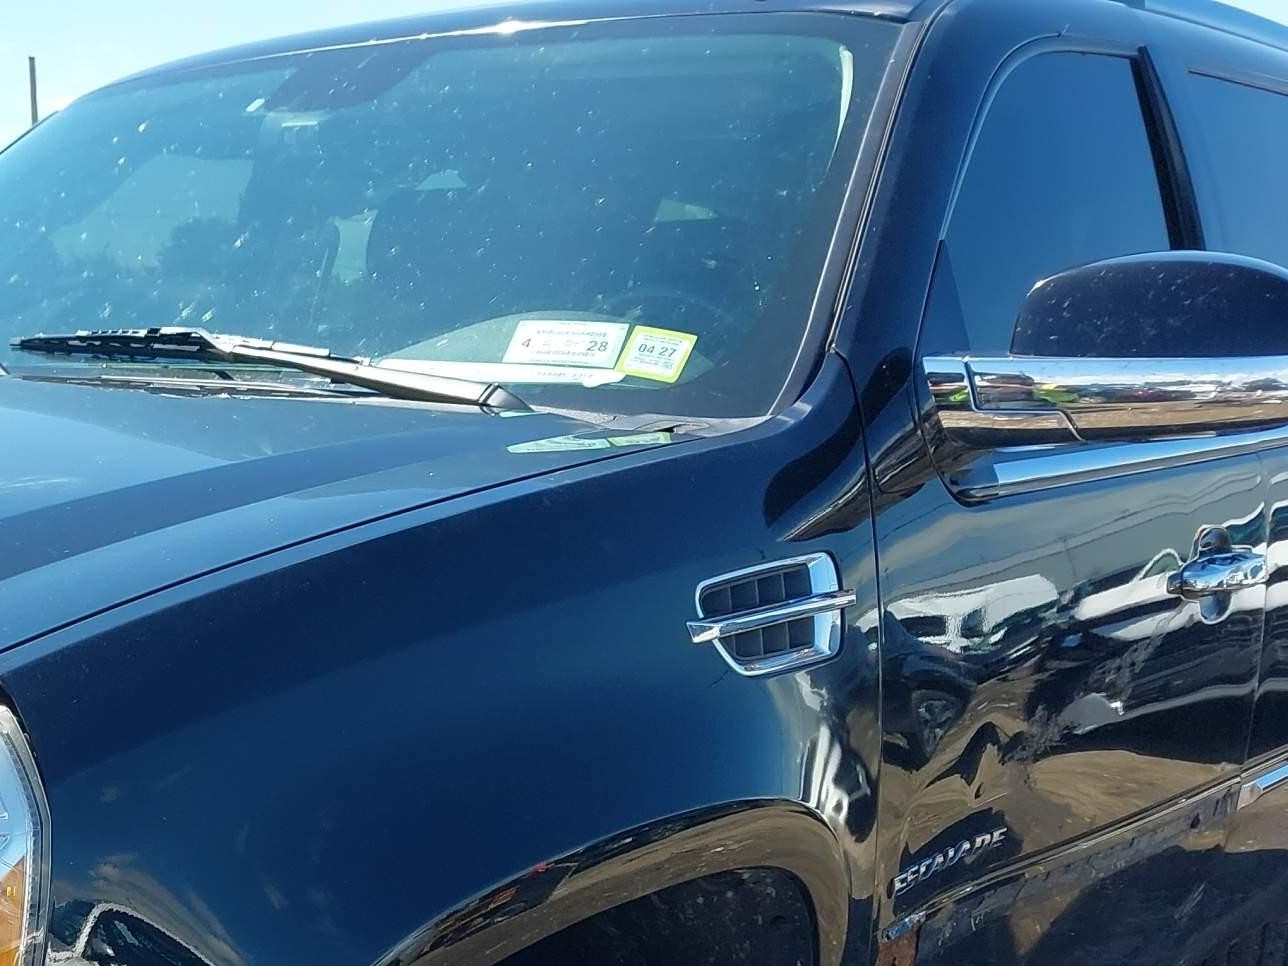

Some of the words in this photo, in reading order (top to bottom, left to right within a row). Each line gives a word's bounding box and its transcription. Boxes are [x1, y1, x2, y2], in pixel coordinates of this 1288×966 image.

[584, 339, 609, 352] 28
[637, 343, 656, 354] 04
[657, 346, 678, 358] 27
[893, 827, 1008, 896] ESCALADE
